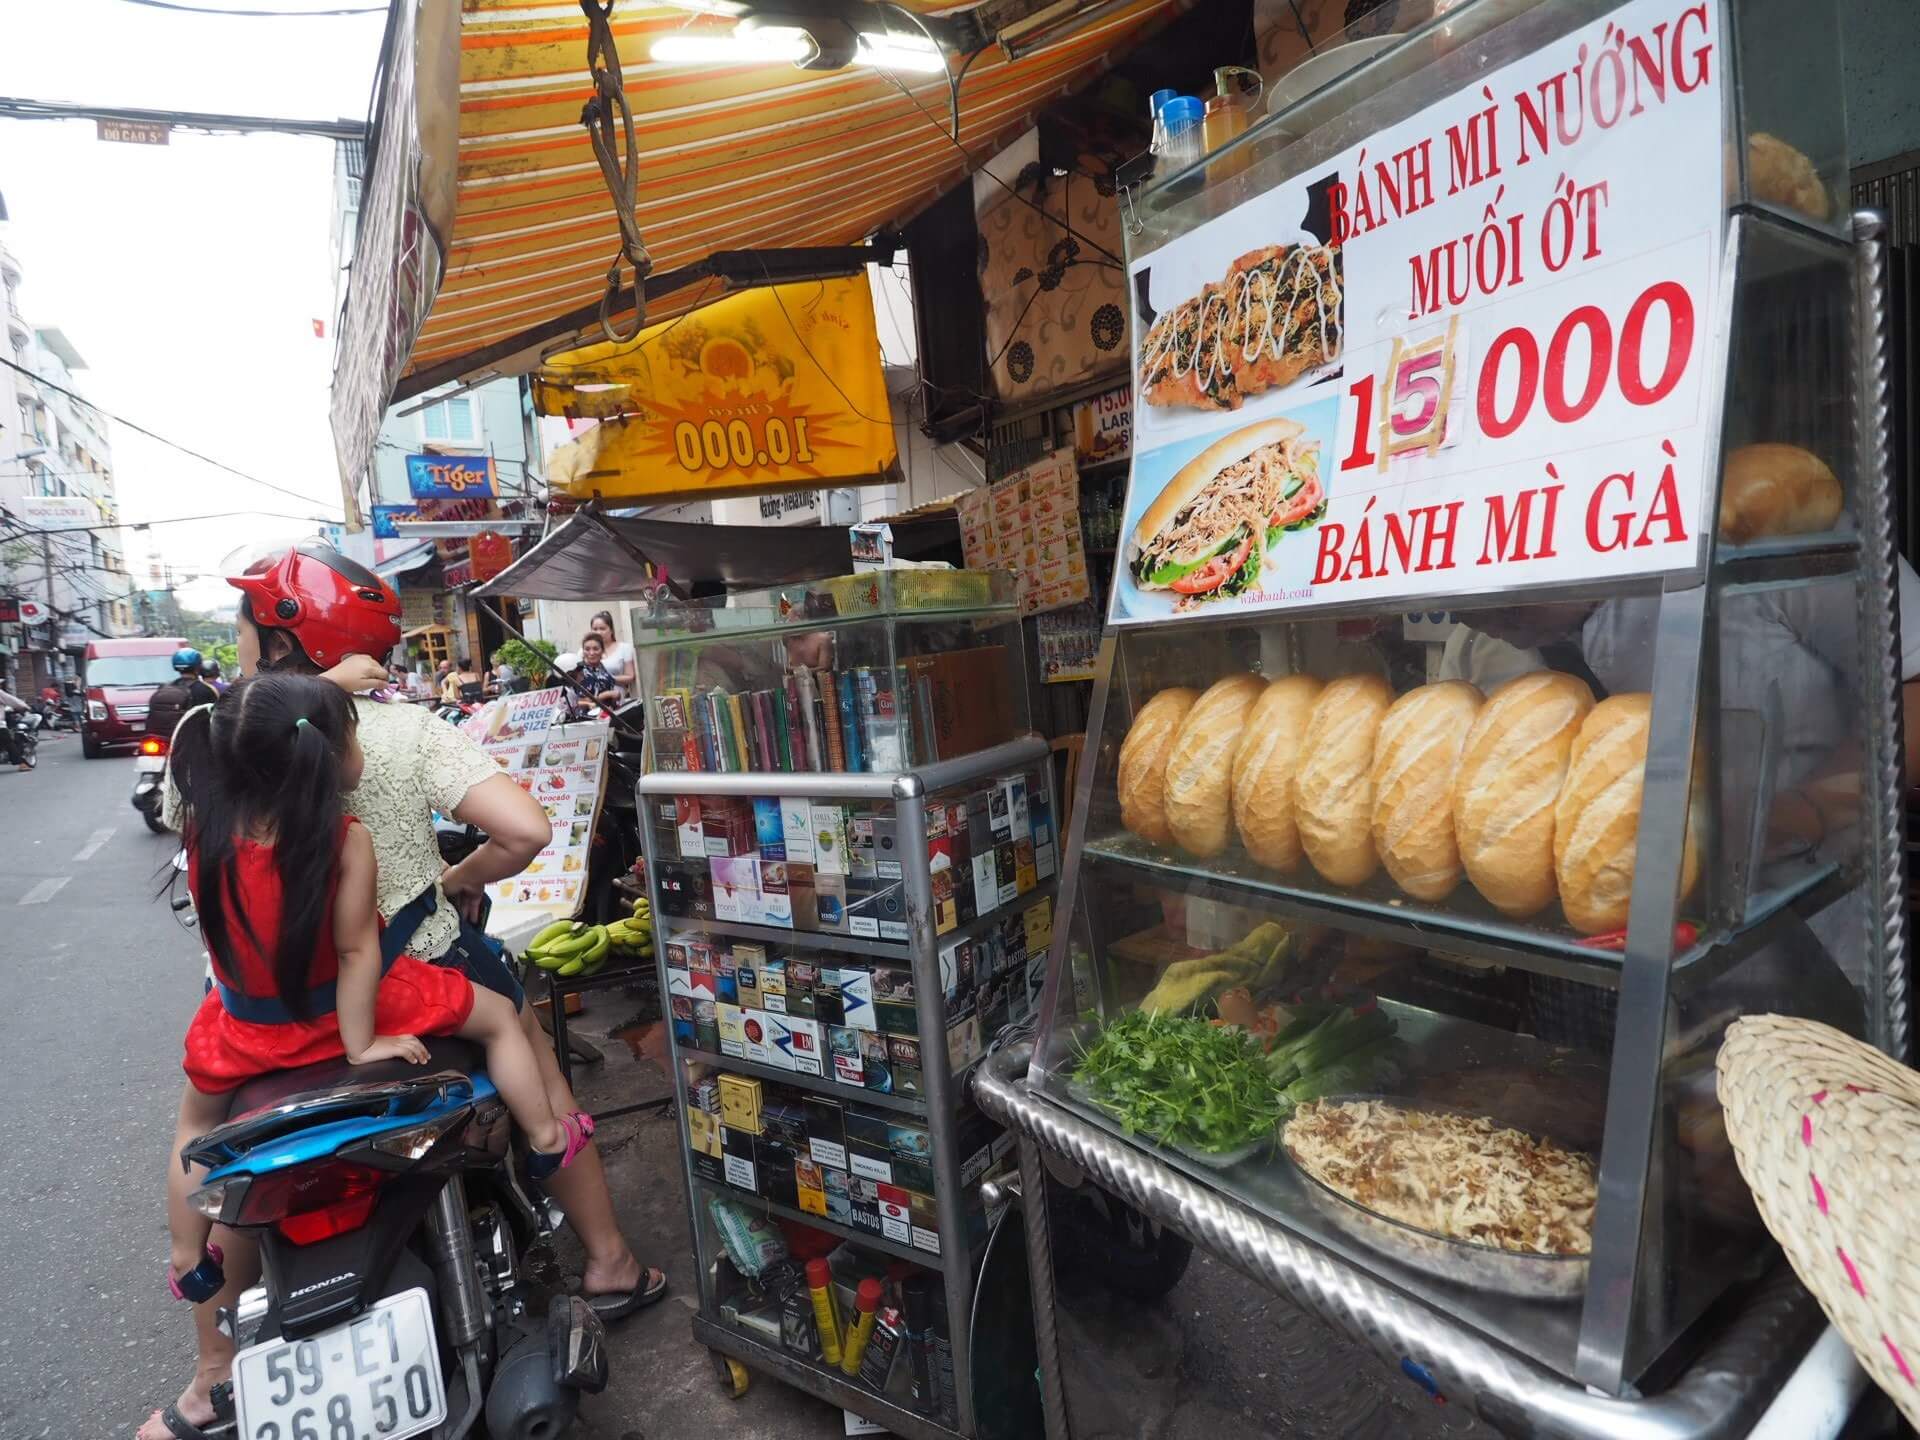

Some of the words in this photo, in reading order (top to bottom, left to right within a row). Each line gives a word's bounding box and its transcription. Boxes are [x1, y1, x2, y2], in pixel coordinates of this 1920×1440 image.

[122, 130, 146, 143] CAO
[1327, 147, 1434, 249] BÁNH
[1444, 85, 1503, 196] MÌ
[1514, 3, 1714, 166] NƯỚNG
[1408, 186, 1525, 321] MUỐI
[1541, 173, 1610, 273] ỚT
[1102, 410, 1132, 431] LAR
[426, 463, 486, 491] Tiger
[1310, 496, 1466, 586] BÁNH
[1475, 462, 1565, 566] MÌ
[1585, 439, 1689, 553] GÀ
[511, 707, 552, 723] LARGE
[523, 719, 548, 732] SIZE
[547, 740, 580, 750] Coconut
[538, 794, 571, 802] Avocado
[852, 1209, 880, 1230] BASTOS
[290, 1272, 355, 1299] HONDA
[266, 1311, 400, 1406] 59-E1
